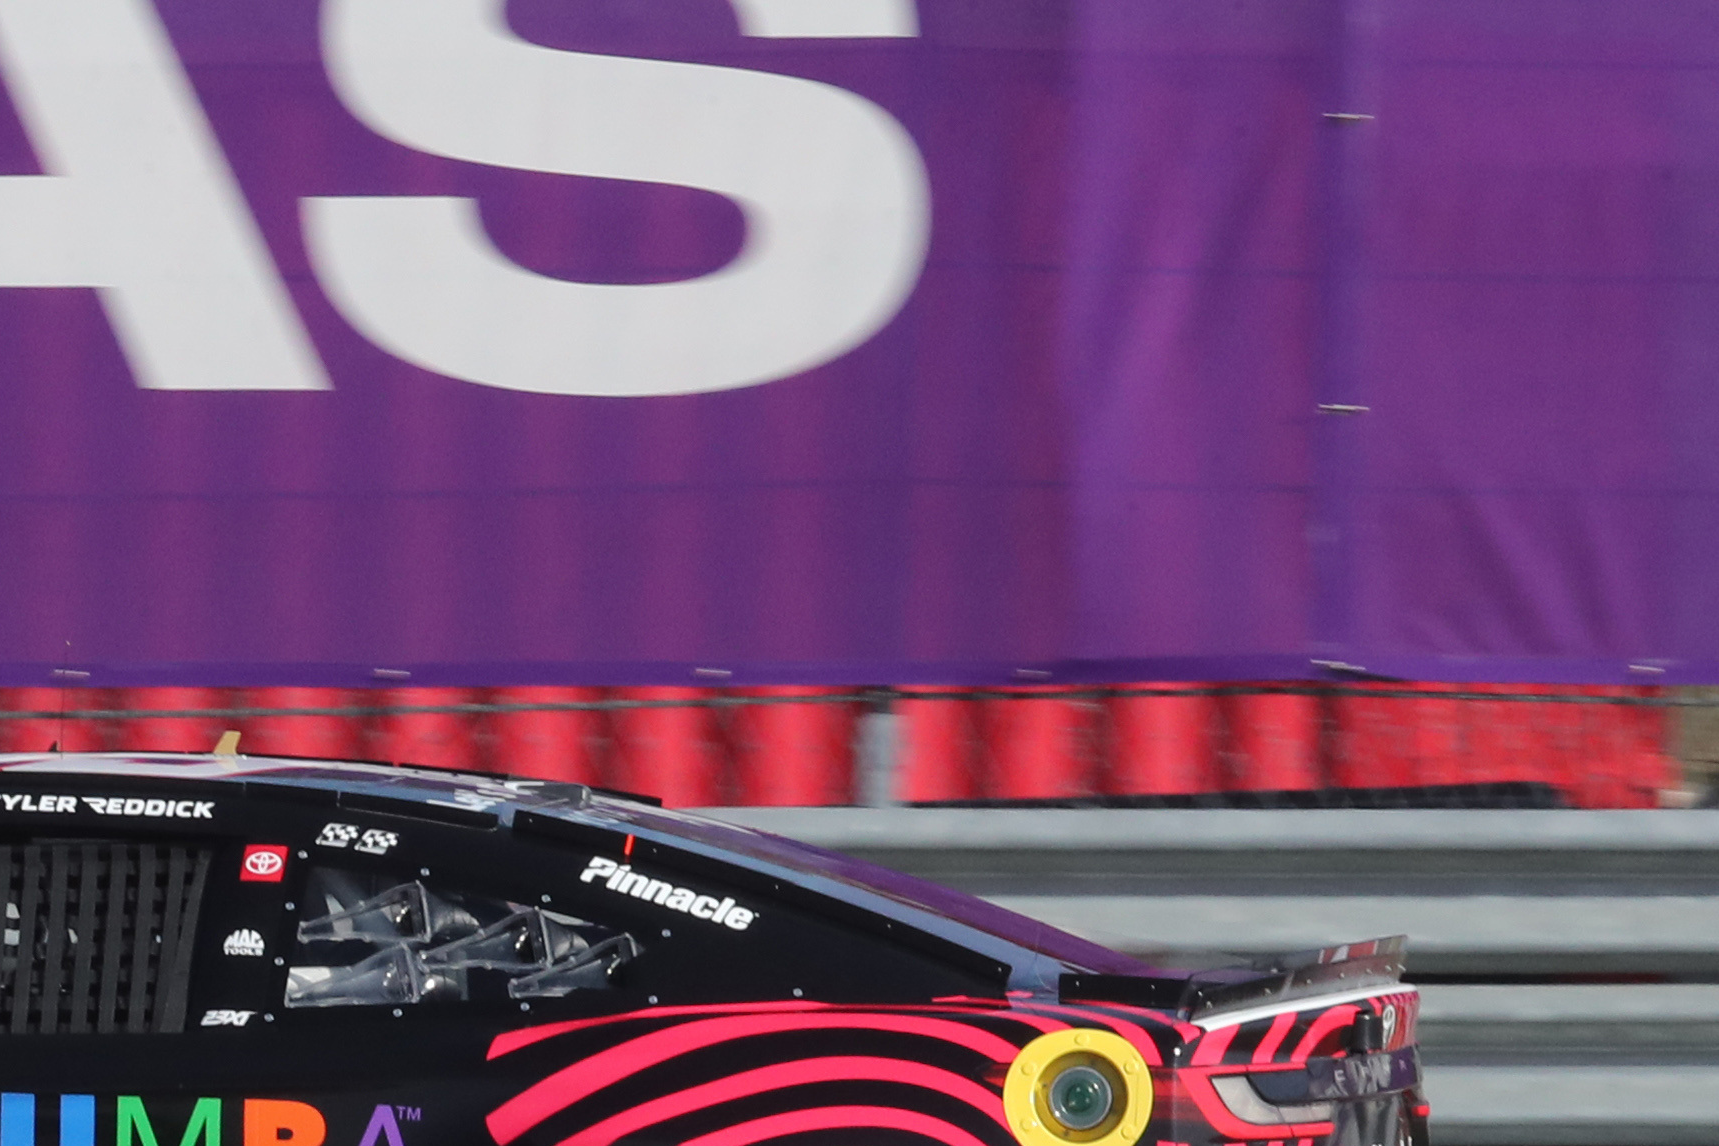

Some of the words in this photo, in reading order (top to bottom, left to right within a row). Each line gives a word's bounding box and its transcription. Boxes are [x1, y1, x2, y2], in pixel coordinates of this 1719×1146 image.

[81, 796, 216, 819] REDDICK
[579, 856, 755, 931] Pinnacle
[222, 928, 266, 949] MAC
[224, 946, 265, 957] TOOLS
